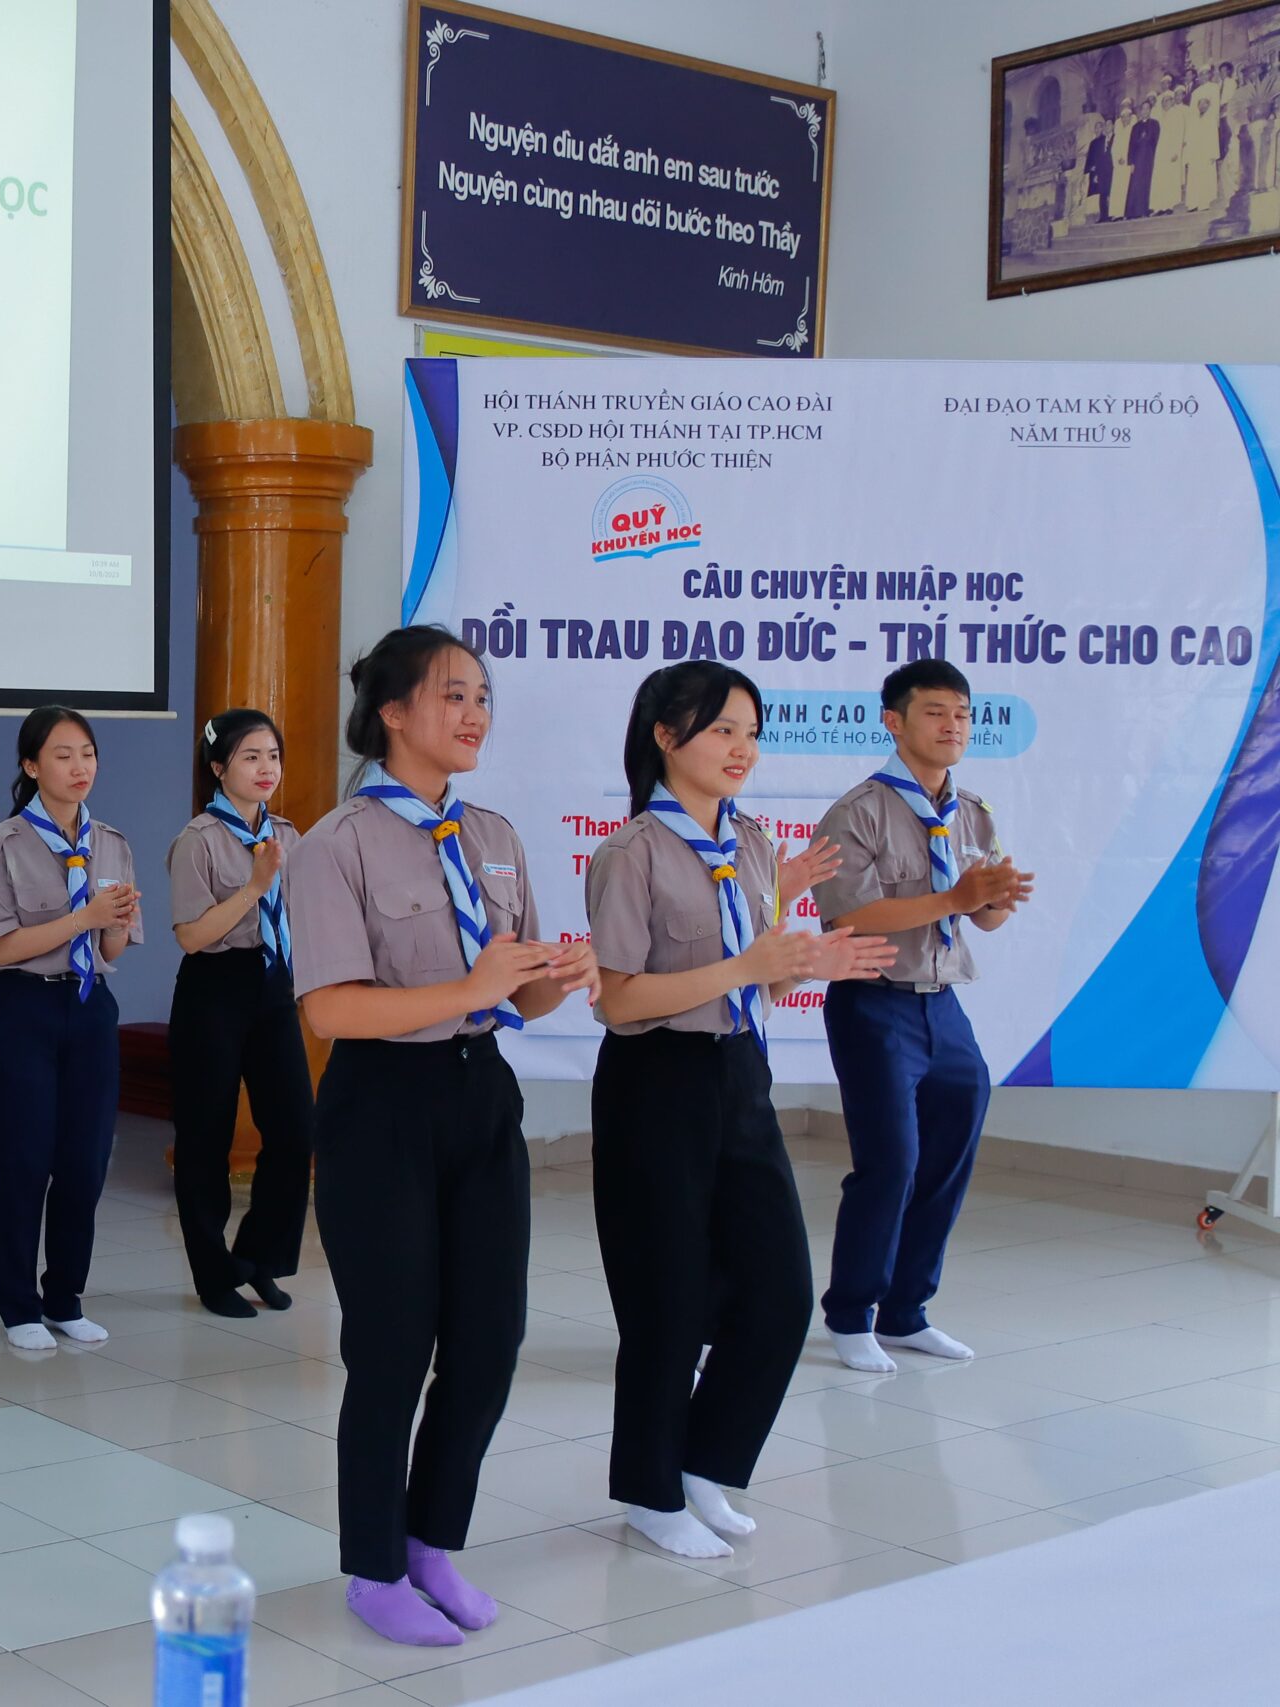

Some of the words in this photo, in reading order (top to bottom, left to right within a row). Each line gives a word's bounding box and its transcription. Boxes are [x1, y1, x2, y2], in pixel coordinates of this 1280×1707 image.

[469, 112, 547, 157] Nguyện
[553, 130, 583, 161] dìu
[588, 134, 620, 168] dắt
[623, 147, 659, 176] anh
[663, 157, 693, 182] em
[698, 164, 731, 190] sau
[735, 167, 780, 199] trước
[438, 161, 517, 206] Nguyện
[523, 178, 573, 219] cùng
[579, 189, 627, 222] nhau
[631, 198, 661, 228] dõi
[665, 203, 711, 237] bước
[715, 214, 755, 244] theo
[758, 220, 801, 259] Thầy
[751, 271, 784, 297] Hôm
[483, 390, 519, 413] HỘI
[524, 390, 596, 410] THÁNH
[602, 388, 685, 411] TRUYỀN
[690, 391, 742, 411] GIÁO
[747, 395, 791, 411] CAO
[796, 392, 832, 412] ĐÀI
[944, 397, 980, 416] ĐẠI
[986, 397, 1031, 416] ĐẠO
[1036, 398, 1081, 414] TAM
[1088, 394, 1117, 414] KỲ
[1122, 392, 1164, 415] PHỔ
[1169, 395, 1199, 418] ĐỘ
[493, 422, 523, 438] VP.
[528, 423, 583, 439] CSĐD
[589, 419, 625, 441] HỘI
[630, 420, 701, 439] THÁNH
[707, 424, 741, 442] TẠI
[747, 424, 823, 440] TP.HCM
[1010, 423, 1057, 442] NĂM
[1063, 423, 1106, 443] THỨ
[1111, 427, 1132, 443] 98
[541, 448, 570, 470] BỘ
[575, 448, 631, 470] PHẬN
[636, 448, 706, 468] PHƯỚC
[711, 449, 772, 471] THIỆN
[611, 504, 666, 532] QUỸ
[591, 528, 660, 555] KHUYẾN
[667, 523, 702, 541] HỌC
[683, 562, 742, 599] CÂU
[751, 563, 867, 611] CHUYỆN
[876, 564, 957, 611] NHẬP
[966, 572, 1023, 611] HỌC
[461, 602, 527, 659] DỒI
[539, 618, 649, 660] TRAU
[757, 612, 837, 662] ĐỨC
[879, 613, 948, 663] TRÍ
[959, 614, 1066, 664] THỨC
[1078, 624, 1159, 665] CHO
[1170, 625, 1253, 667] CAO
[821, 704, 866, 724] CAO
[758, 730, 779, 743] AN
[843, 731, 867, 747] HỌ
[870, 731, 892, 747] ĐẠ
